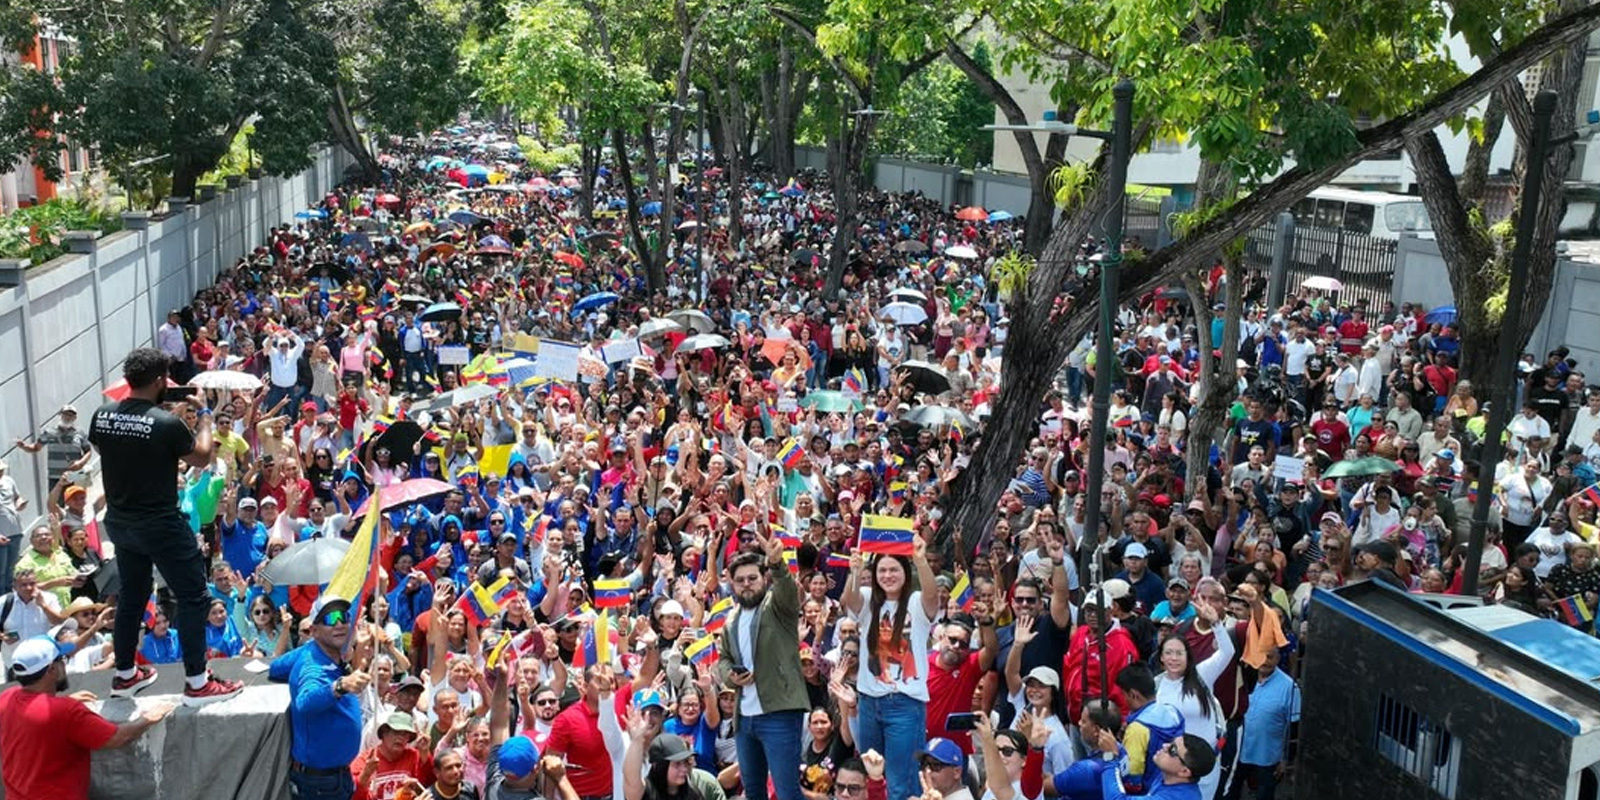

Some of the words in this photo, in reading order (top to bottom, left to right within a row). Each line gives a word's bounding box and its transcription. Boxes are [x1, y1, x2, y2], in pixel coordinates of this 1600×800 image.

[97, 411, 108, 419] LA
[96, 419, 112, 429] DEL
[114, 421, 152, 434] FUTURO
